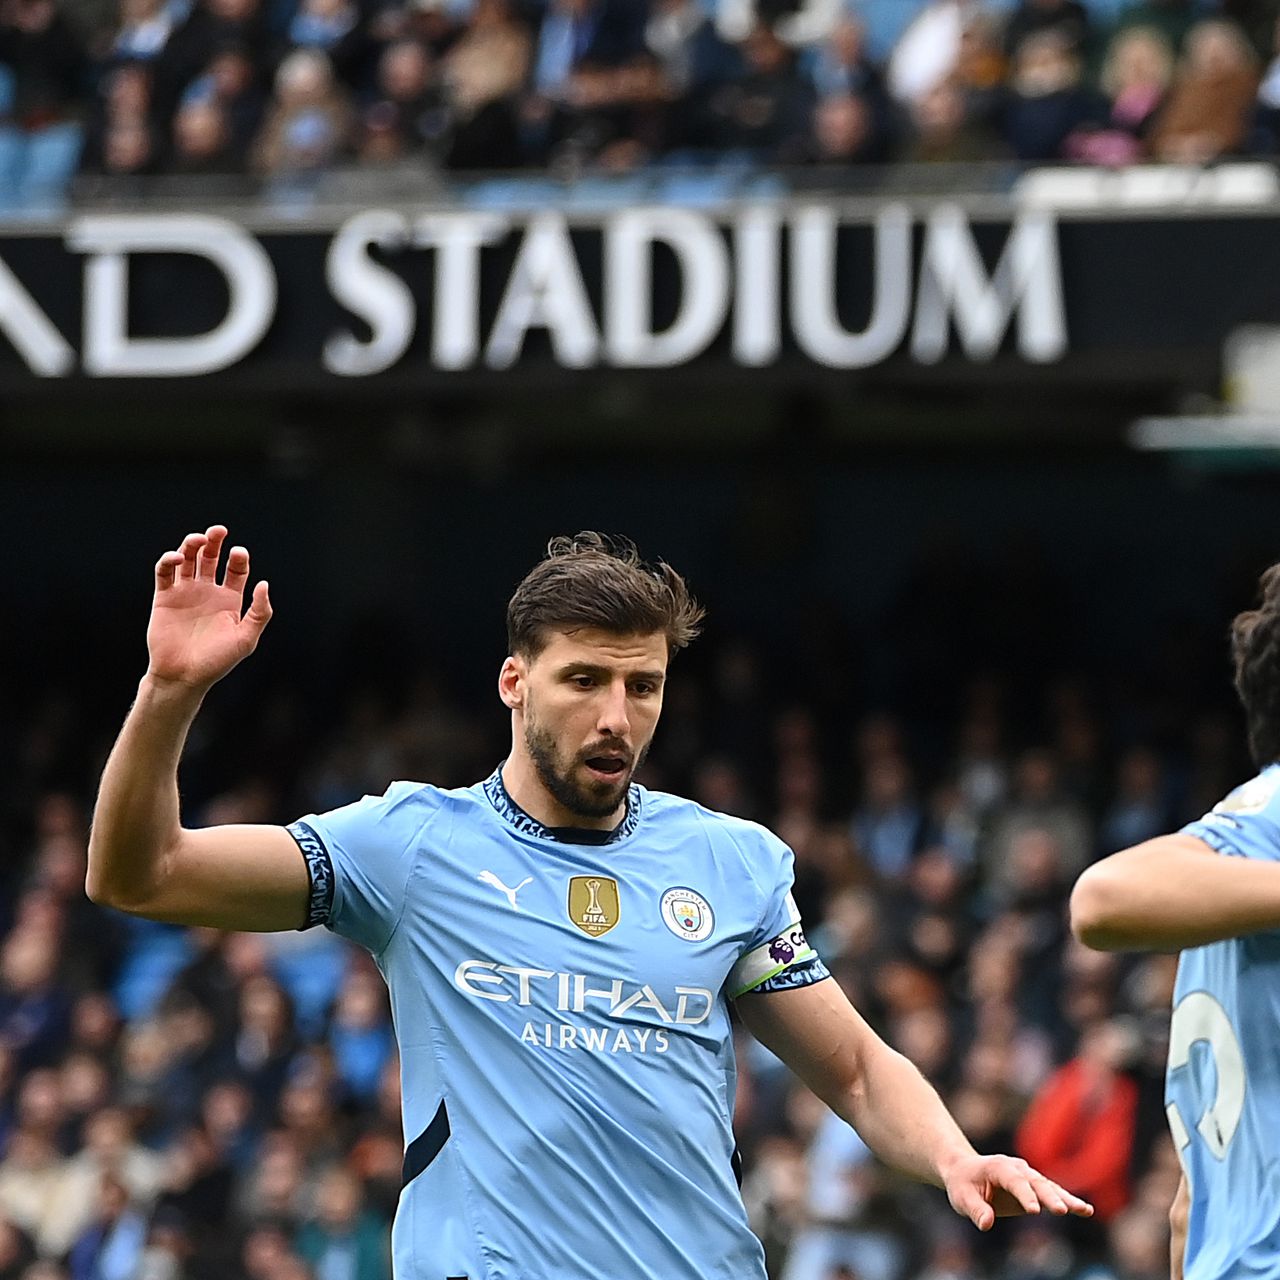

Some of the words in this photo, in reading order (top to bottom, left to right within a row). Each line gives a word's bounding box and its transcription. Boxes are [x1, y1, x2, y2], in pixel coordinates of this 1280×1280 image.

[322, 204, 1067, 378] STADIUM
[582, 914, 606, 923] FIFA
[454, 960, 713, 1025] ETIHAD
[520, 1022, 670, 1053] AIRWAYS
